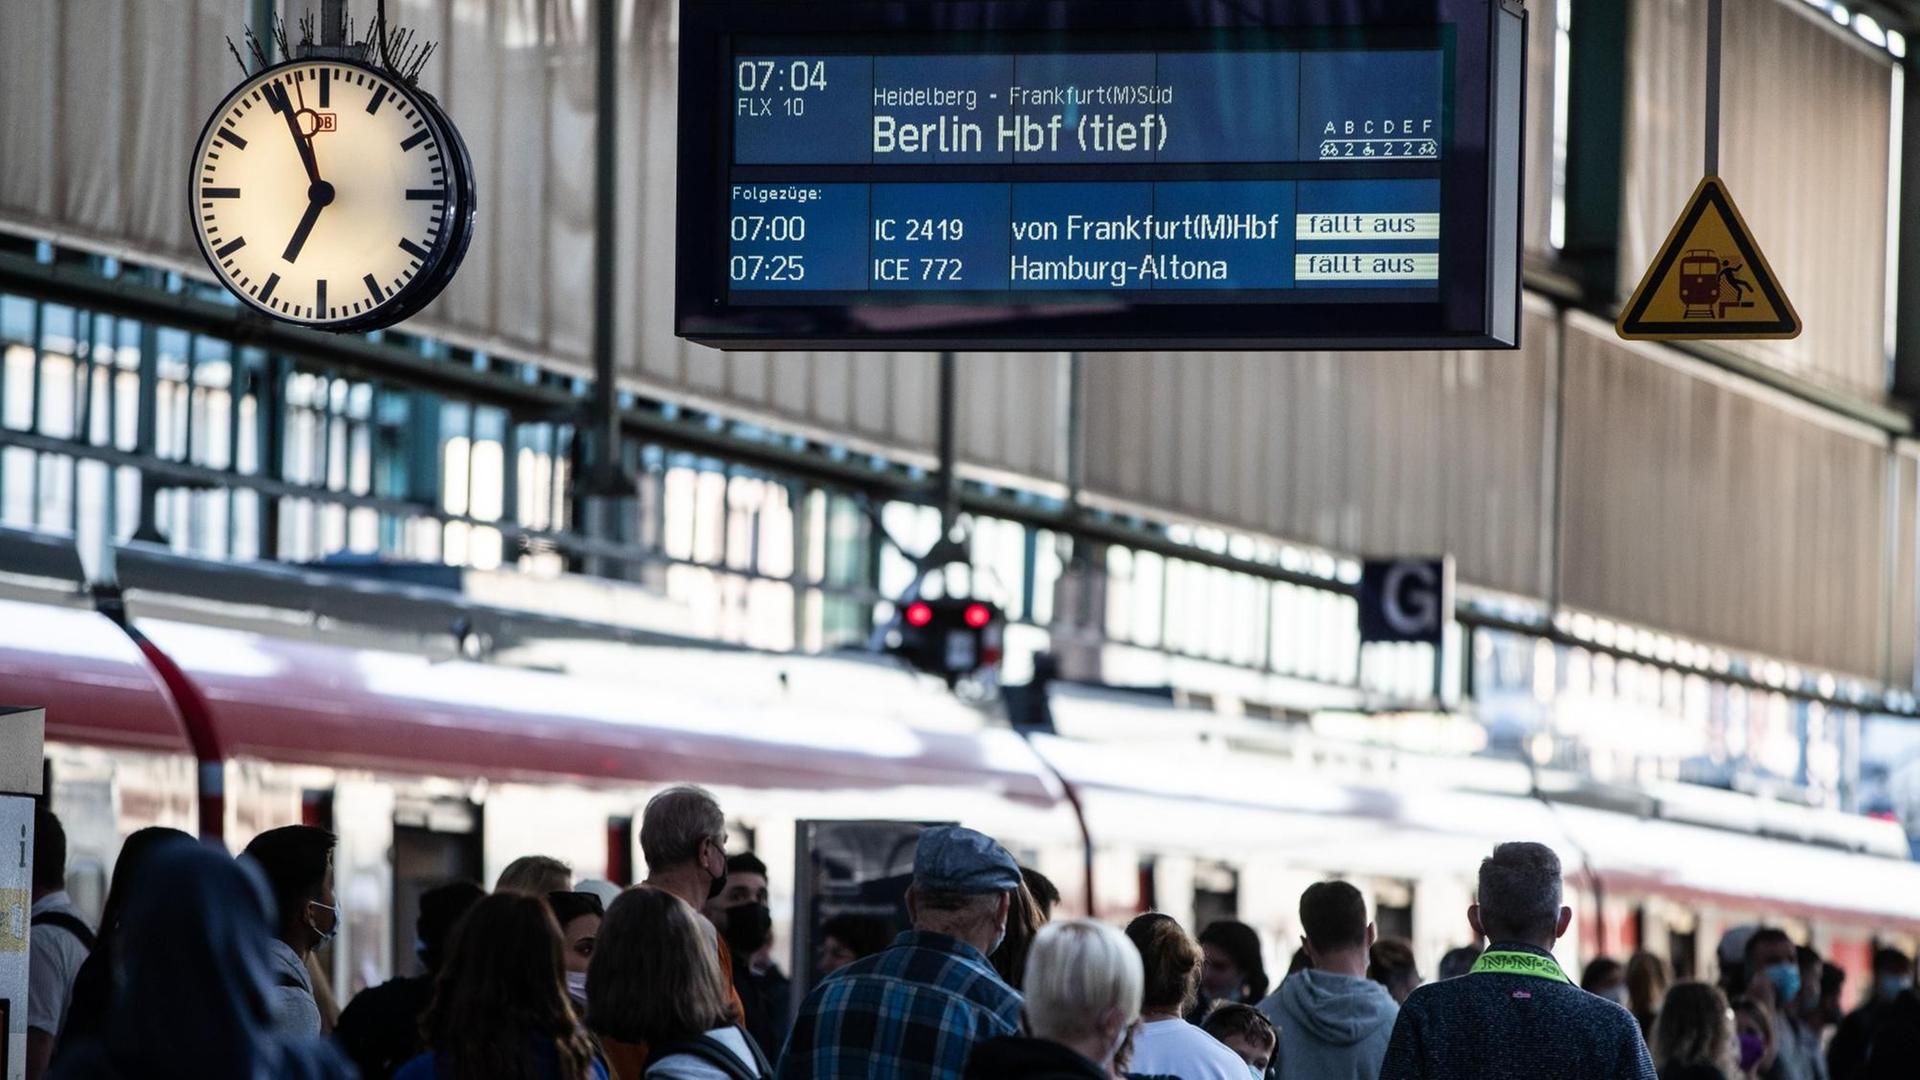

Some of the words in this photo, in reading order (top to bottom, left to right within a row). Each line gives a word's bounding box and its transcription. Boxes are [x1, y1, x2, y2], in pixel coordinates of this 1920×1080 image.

[738, 61, 827, 91] 07:04
[738, 98, 772, 117] FLX
[783, 97, 804, 116] 10
[874, 87, 977, 111] Heidelberg
[1010, 85, 1173, 105] Frankfurt(M)Süd
[873, 115, 982, 153] Berlin
[997, 114, 1062, 152] Hbf
[1077, 113, 1167, 152] (tief)
[1323, 121, 1336, 135] A
[1344, 121, 1355, 135] B
[1364, 120, 1374, 134] C
[1384, 120, 1395, 134] D
[1403, 120, 1413, 134] E
[1423, 119, 1432, 133] F
[1344, 142, 1354, 156] 2
[1383, 142, 1393, 156] 2
[1403, 142, 1412, 156] 2
[732, 186, 823, 203] Folgezüge:
[731, 215, 805, 241] 07:00
[875, 218, 896, 241] IC
[905, 218, 963, 241] 2419
[1012, 220, 1058, 241] von
[1067, 213, 1279, 241] Frankfurt(M)Hbf
[1310, 215, 1363, 234] fällt
[1373, 217, 1416, 233] aus
[730, 255, 805, 281] 07:25
[874, 258, 910, 281] ICE
[920, 258, 963, 281] 772
[1011, 254, 1227, 287] Hamburg-Altona
[1308, 255, 1362, 274] fällt
[1372, 257, 1416, 273] aus
[1382, 562, 1438, 634] G
